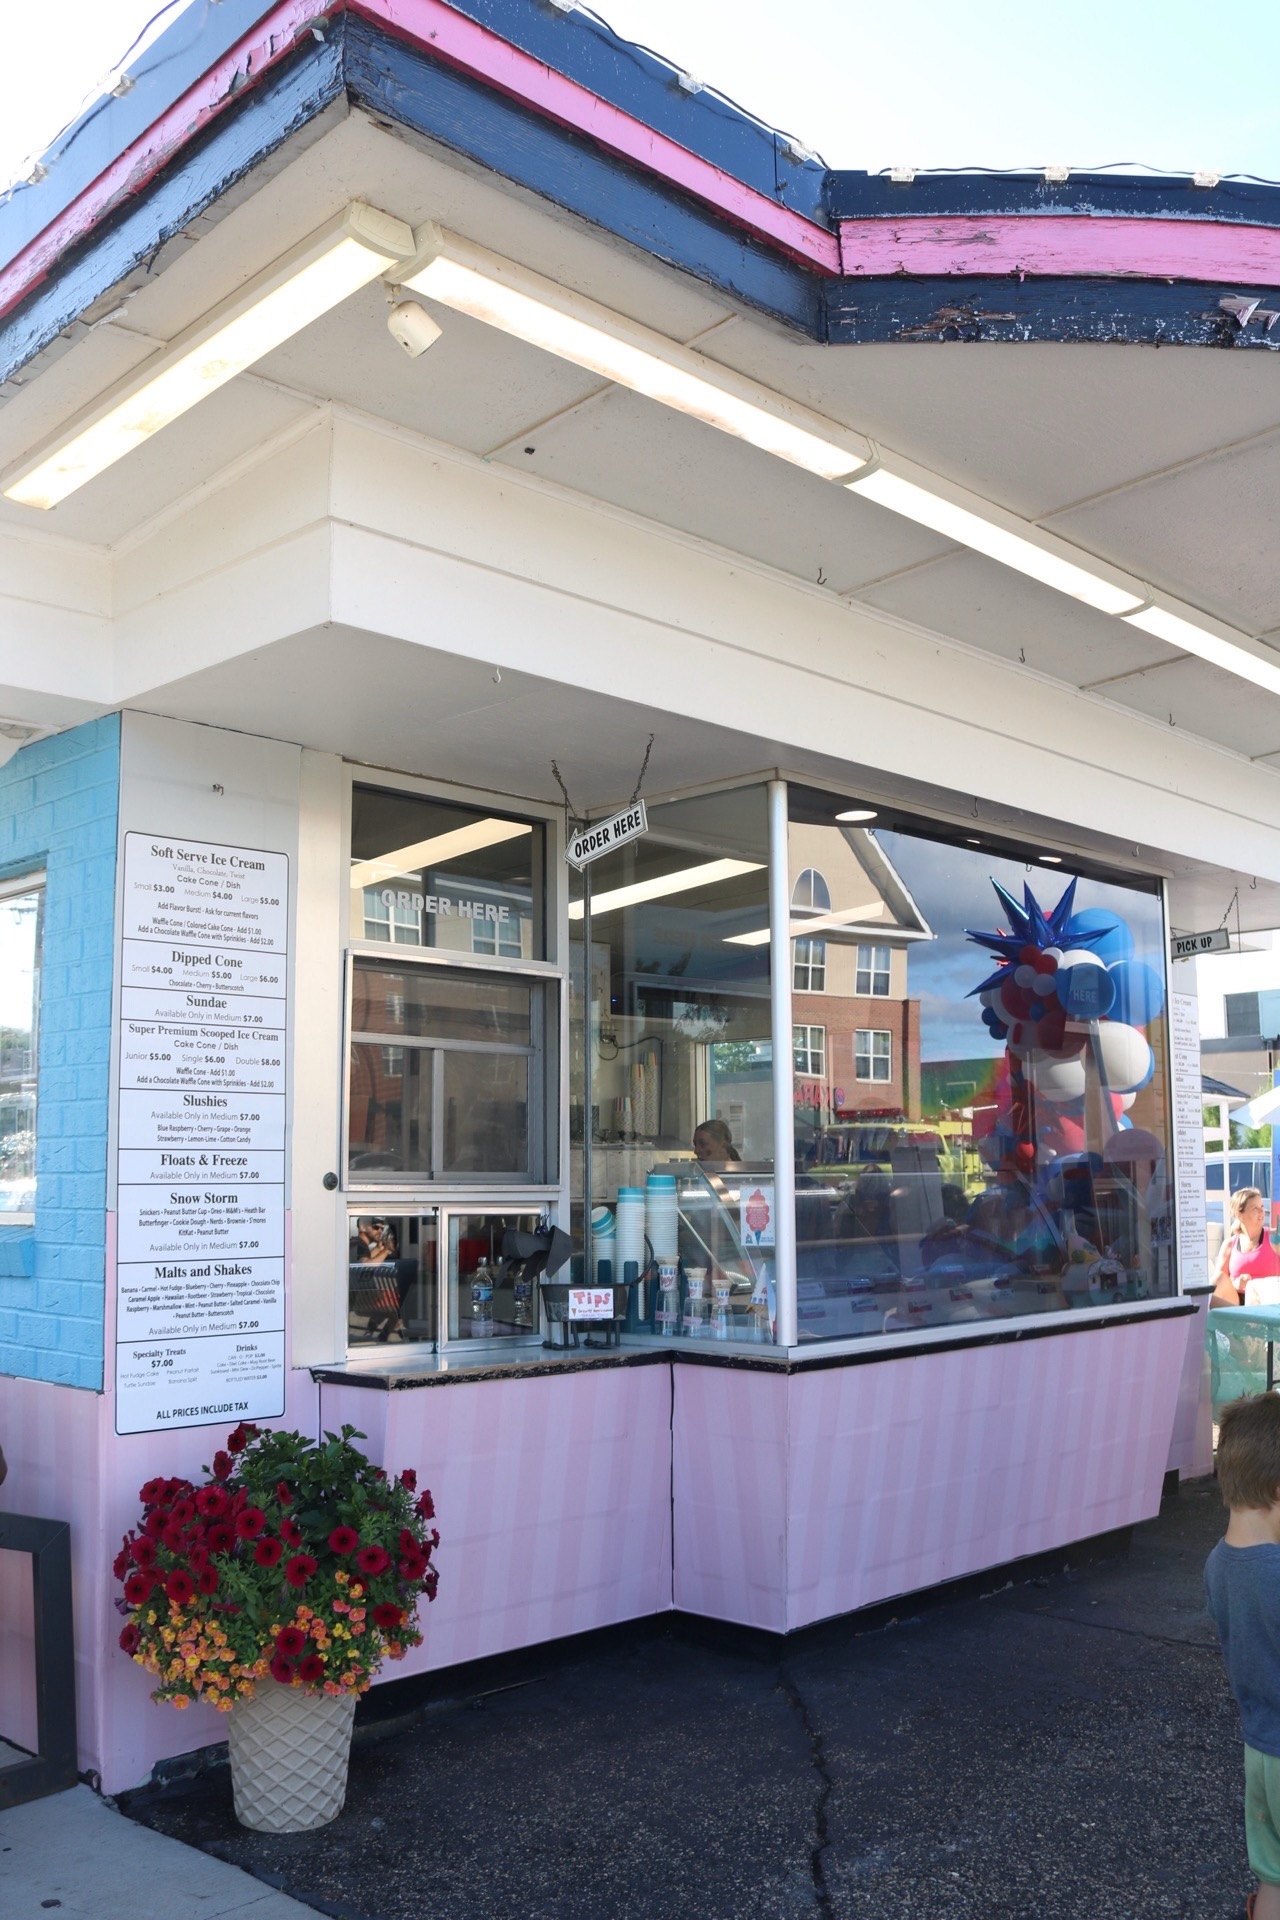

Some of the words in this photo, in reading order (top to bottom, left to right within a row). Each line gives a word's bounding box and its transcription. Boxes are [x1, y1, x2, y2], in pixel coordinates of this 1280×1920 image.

[574, 829, 610, 858] ORDER
[614, 810, 641, 839] HERE
[151, 845, 174, 858] Soft
[177, 849, 207, 863] Serve
[211, 854, 226, 865] Ice
[230, 856, 265, 870] Cream
[177, 875, 196, 884] Cake
[199, 878, 218, 886] Cone
[226, 881, 240, 889] Dish
[134, 882, 152, 890] Small
[154, 885, 174, 893] $3.00
[184, 889, 211, 898] Medium
[213, 892, 232, 900] $4.00
[241, 896, 259, 904] Large
[260, 898, 279, 906] $5.00
[170, 904, 185, 912] Flavor
[381, 889, 451, 916] ORDER
[458, 900, 510, 924] HERE
[154, 927, 179, 936] Chocolate
[181, 930, 196, 938] Waffle
[224, 934, 246, 943] Sprinkles
[1177, 938, 1197, 953] PICK
[1201, 936, 1212, 948] UP
[172, 951, 212, 966] Dipped
[215, 956, 242, 967] Cone
[152, 966, 172, 974] $4.00
[260, 975, 278, 983] $6.00
[196, 982, 211, 990] Cherry
[186, 994, 227, 1008] Sundae
[1073, 989, 1096, 1003] HERE
[155, 1009, 186, 1018] Available
[188, 1012, 204, 1021] Only
[214, 1013, 241, 1021] Medium
[129, 1024, 155, 1035] Super
[158, 1026, 198, 1036] Premium
[200, 1029, 235, 1040] Scooped
[238, 1031, 250, 1039] Ice
[252, 1032, 278, 1041] Cream
[125, 1052, 147, 1060] Junior
[150, 1053, 171, 1061] $5.00
[182, 1055, 203, 1063] Single
[183, 1095, 227, 1107] Slushies
[151, 1111, 183, 1120] Available
[184, 1112, 200, 1121] Only
[169, 1125, 193, 1133] Raspberry
[161, 1154, 195, 1165] Floats
[199, 1154, 208, 1165] &
[213, 1154, 248, 1165] Freeze
[184, 1172, 200, 1180] Only
[170, 1193, 200, 1204] Snow
[204, 1192, 238, 1204] Storm
[150, 1244, 182, 1252] Available
[183, 1243, 200, 1252] Only
[155, 1266, 187, 1279] Malts
[190, 1265, 211, 1277] and
[214, 1264, 252, 1276] Shakes
[573, 1292, 610, 1308] Tips
[149, 1326, 181, 1335] Available
[183, 1325, 199, 1334] Only
[209, 1322, 237, 1331] Medium
[238, 1321, 259, 1329] $7.00
[133, 1350, 163, 1359] Specialty
[152, 1359, 173, 1368] $7.00
[157, 1409, 171, 1419] ALL
[173, 1405, 199, 1418] PRICES
[201, 1403, 233, 1414] INCLUDE
[235, 1402, 248, 1410] TAX
